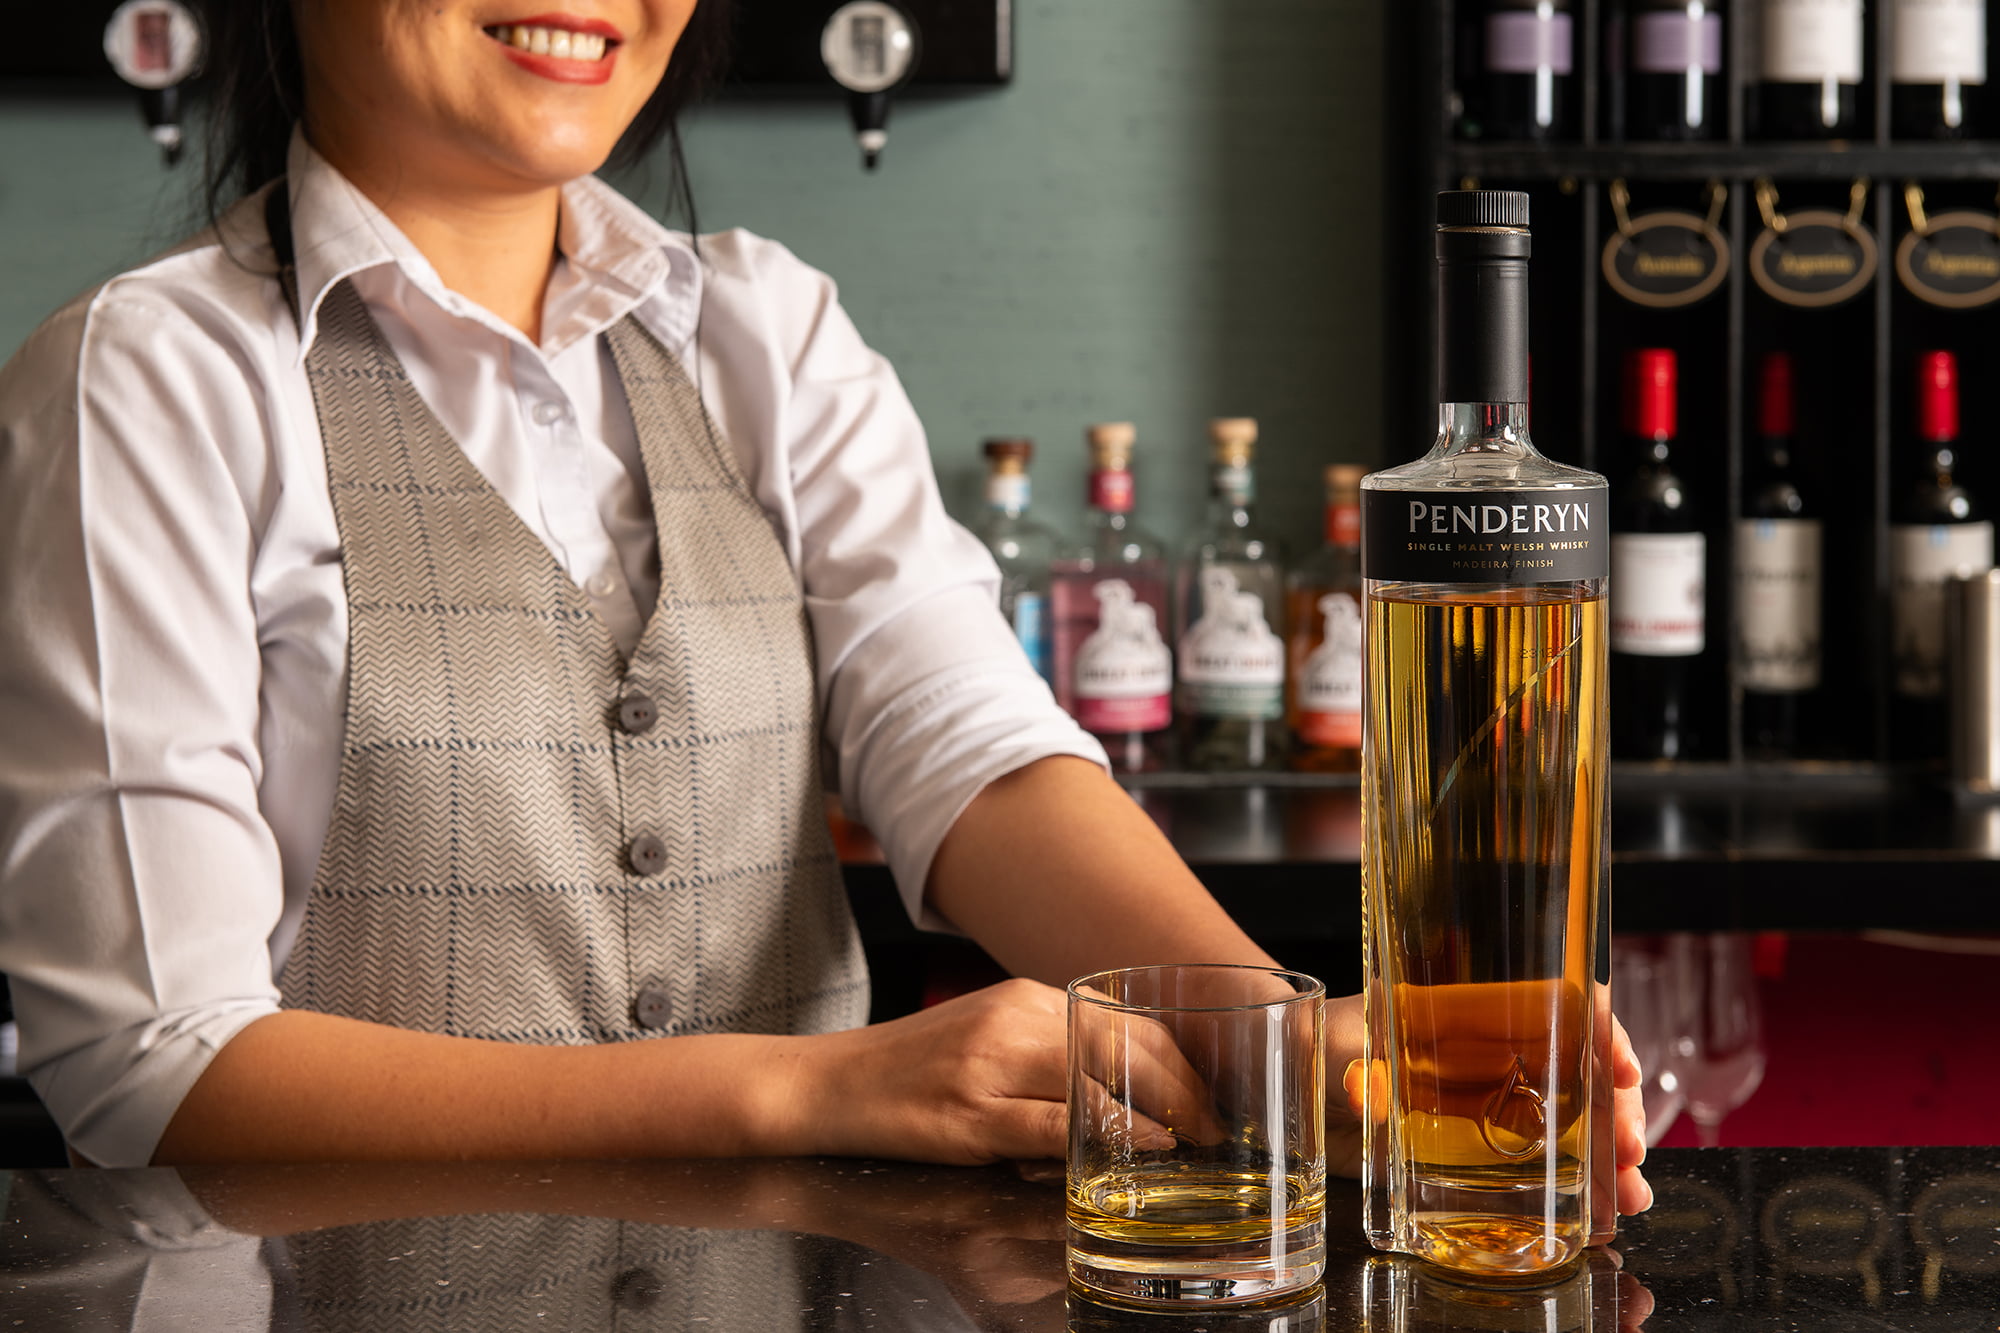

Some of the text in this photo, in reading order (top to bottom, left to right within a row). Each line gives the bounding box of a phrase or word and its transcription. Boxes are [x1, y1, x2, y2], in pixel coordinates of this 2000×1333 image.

[1408, 500, 1590, 534] PENDERYN
[1407, 541, 1590, 552] SINGLE MALT WELSH WHISKY
[1452, 559, 1554, 569] MADEIRA FINISH
